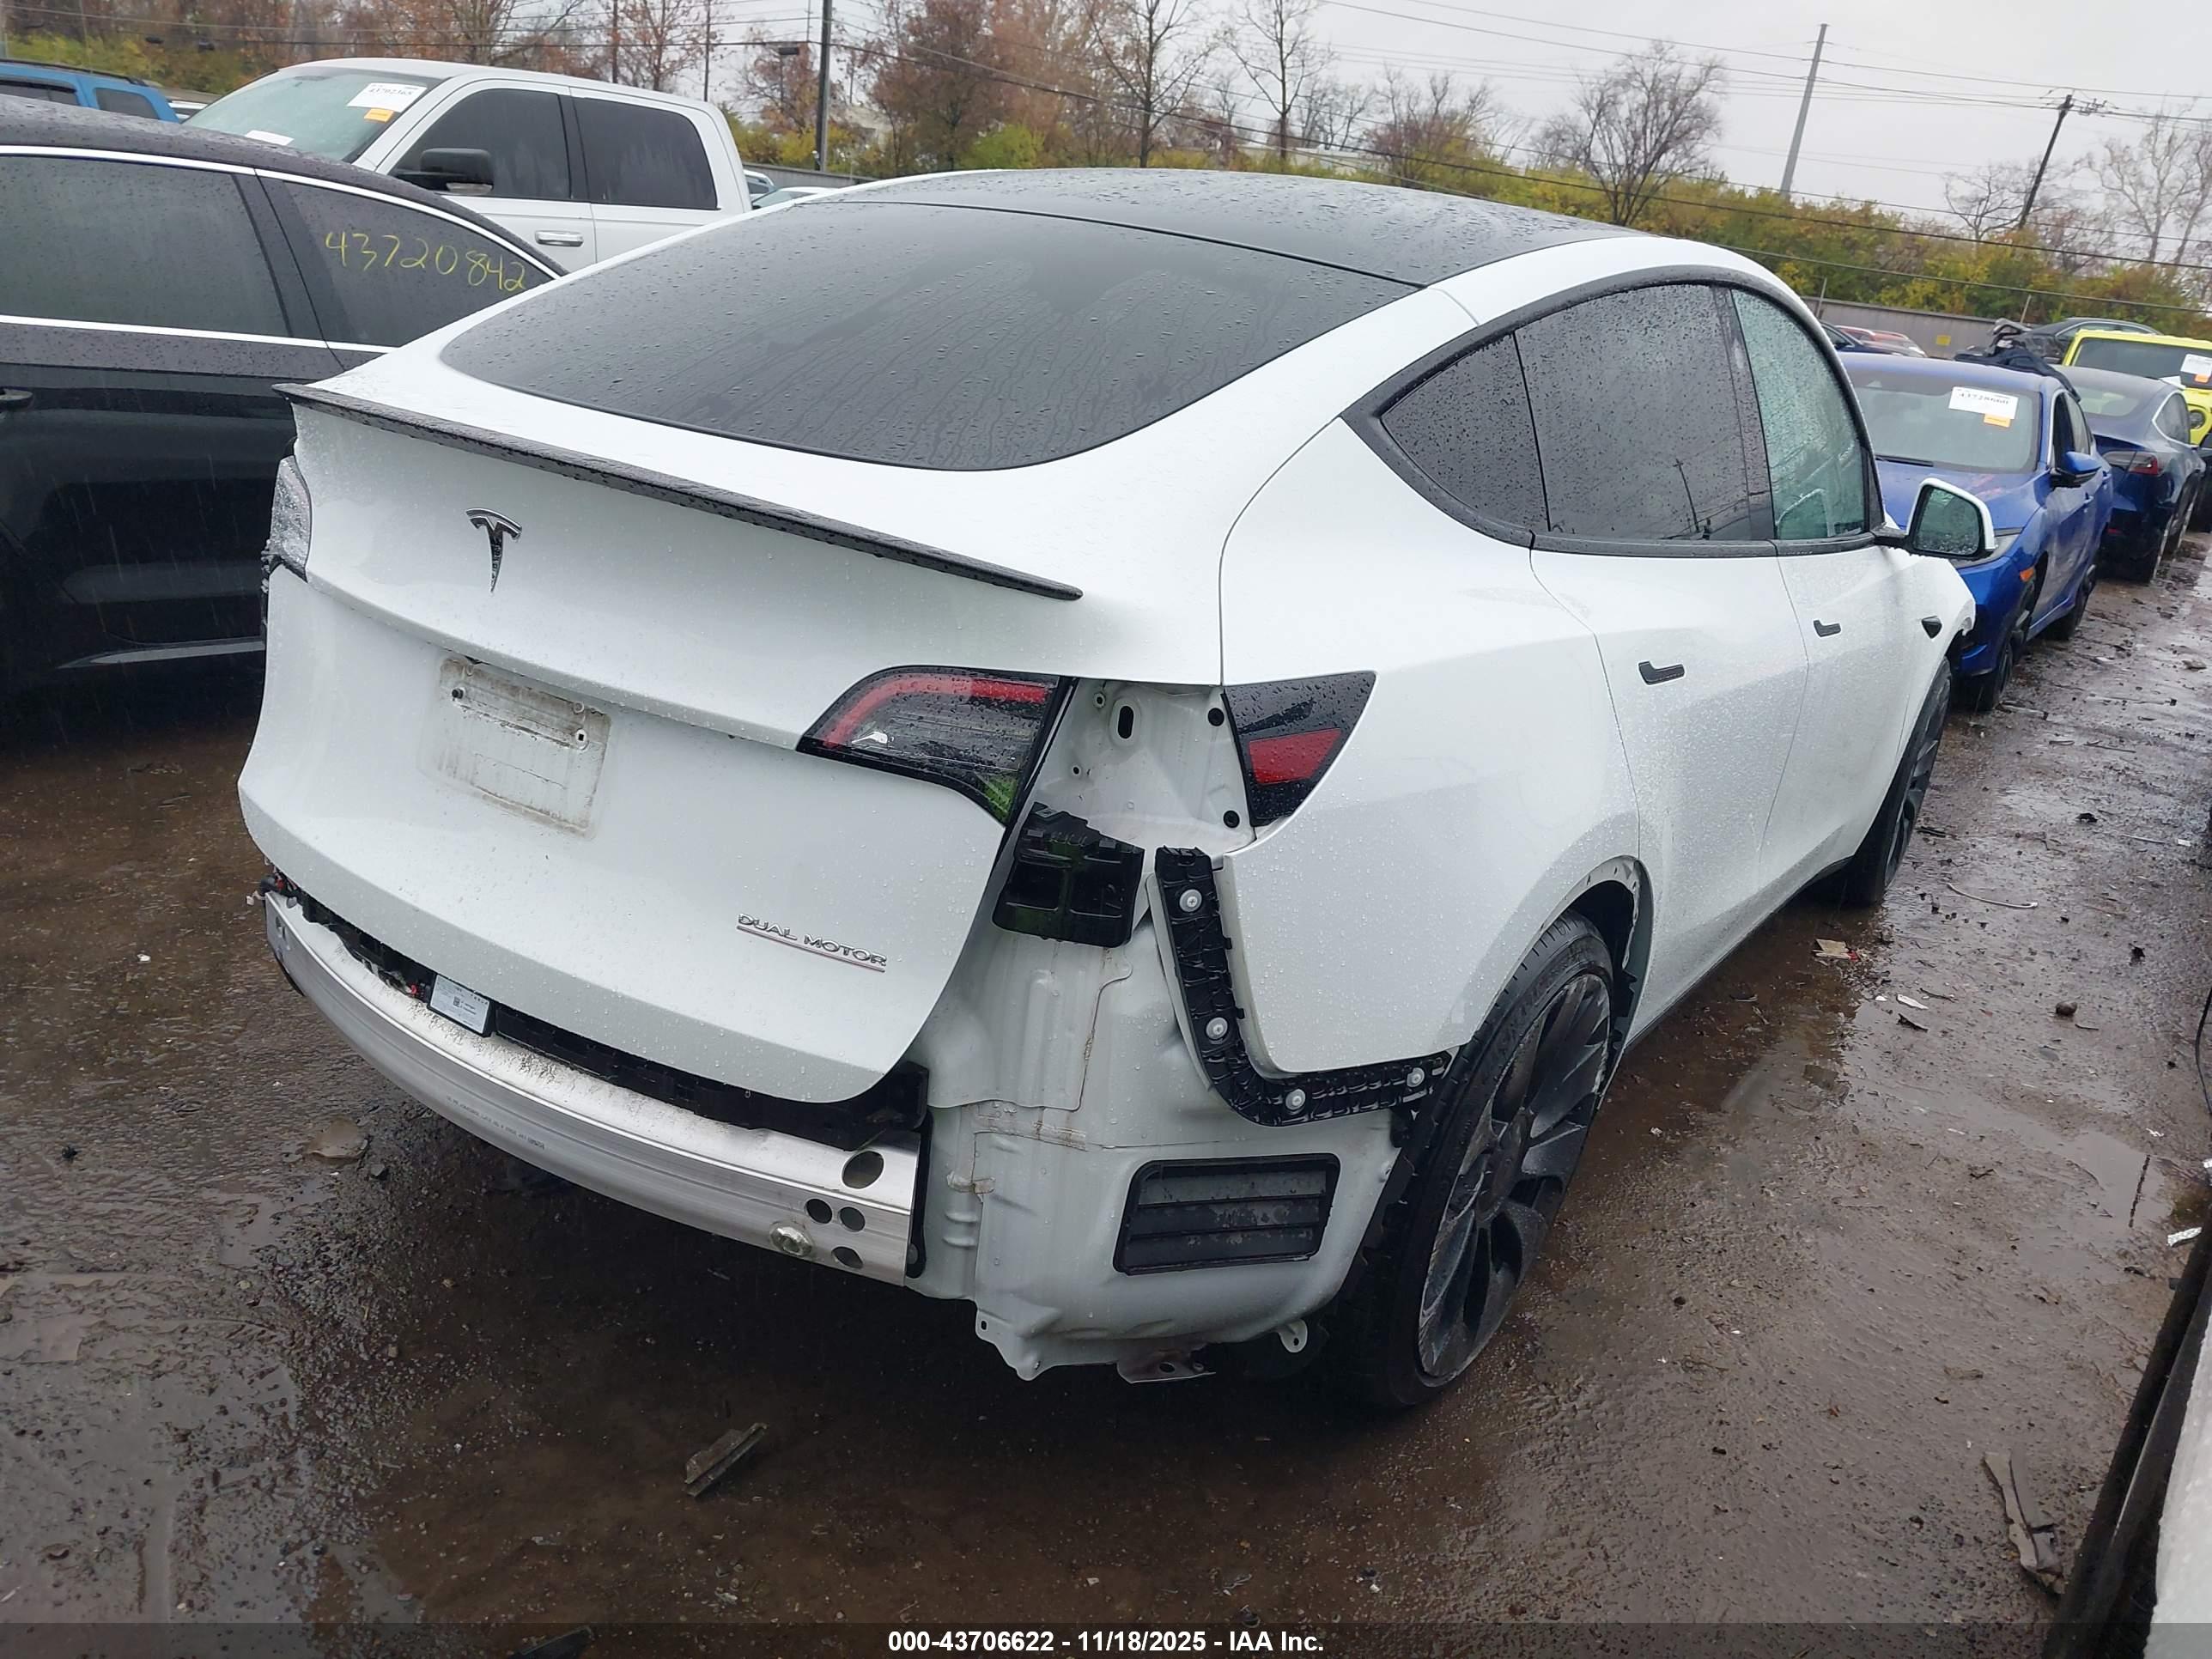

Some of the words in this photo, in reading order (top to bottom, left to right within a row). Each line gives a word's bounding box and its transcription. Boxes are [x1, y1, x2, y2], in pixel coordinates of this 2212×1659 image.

[325, 231, 527, 292] 43720842
[738, 913, 798, 941] DUAL
[803, 933, 887, 967] MOTOR
